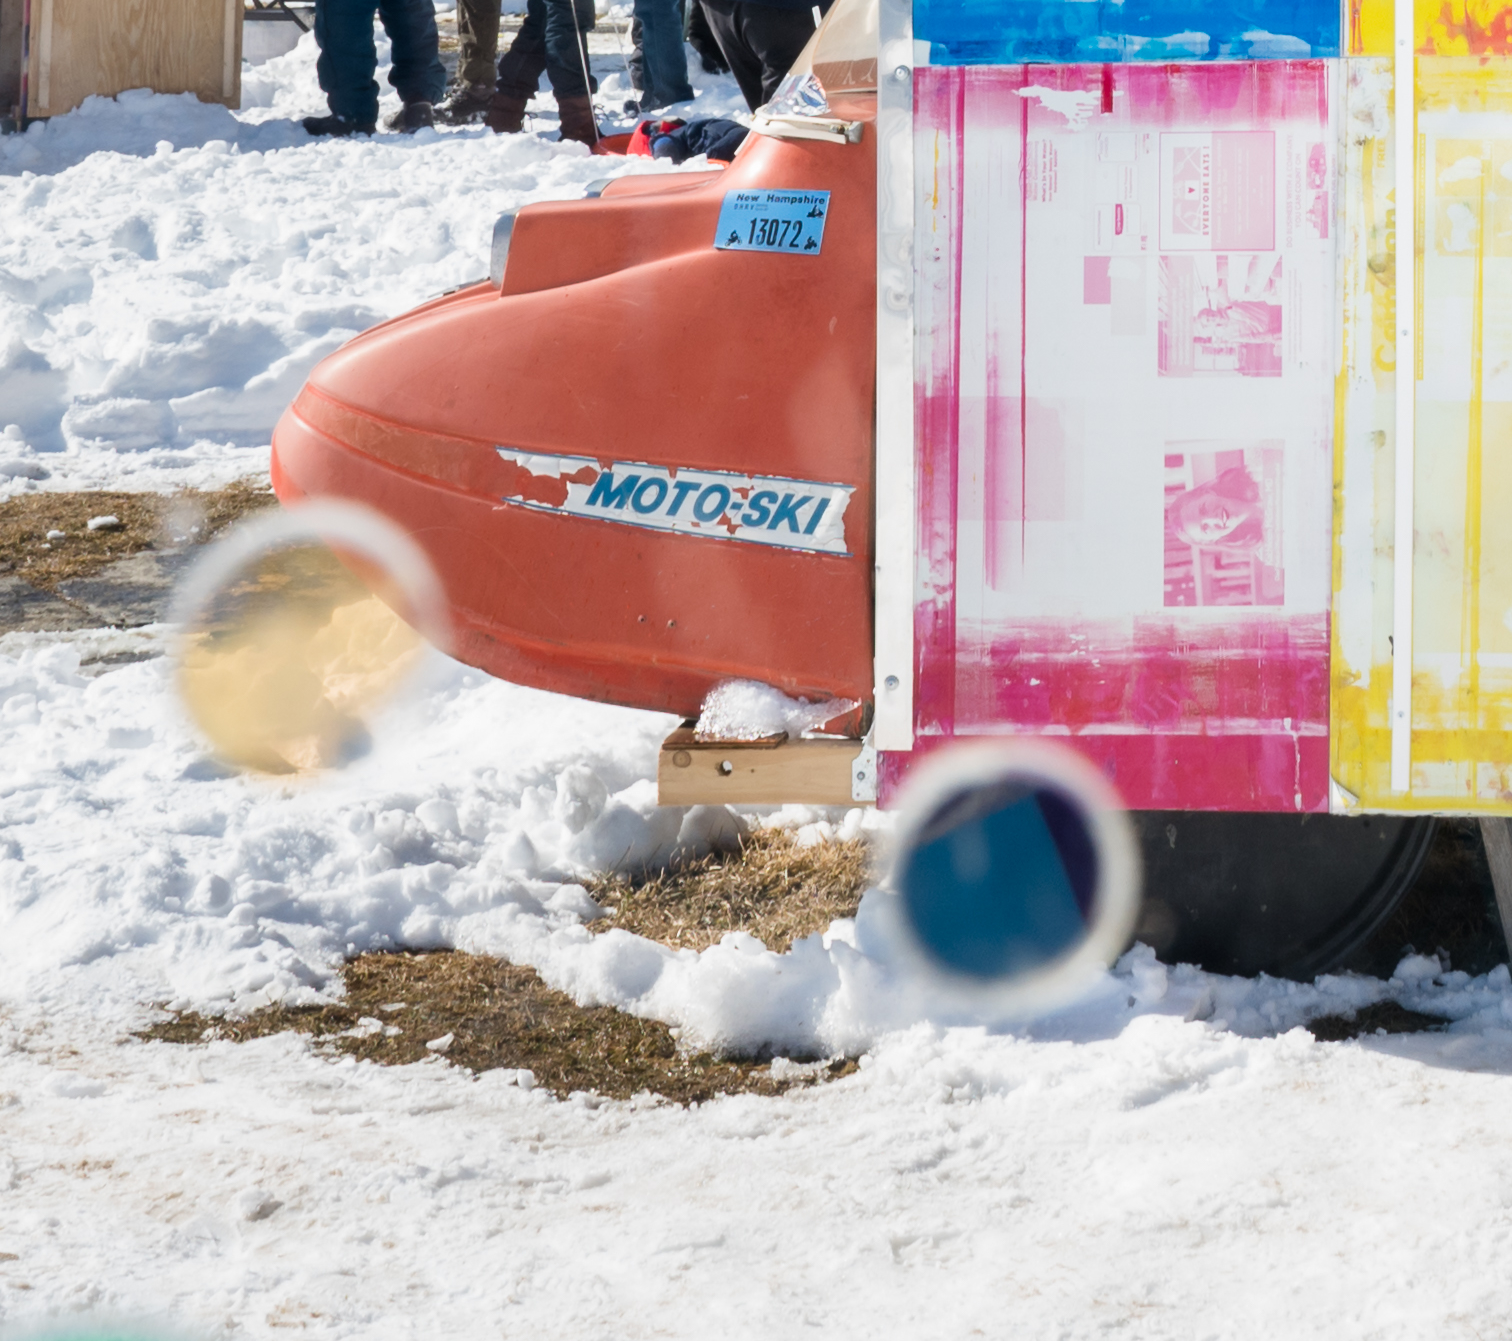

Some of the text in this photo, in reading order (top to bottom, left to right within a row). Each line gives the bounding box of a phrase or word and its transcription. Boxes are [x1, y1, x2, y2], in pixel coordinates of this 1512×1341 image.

[767, 194, 825, 205] Hampshire
[748, 218, 803, 247] 13072
[586, 471, 831, 535] MOTO-SKI
